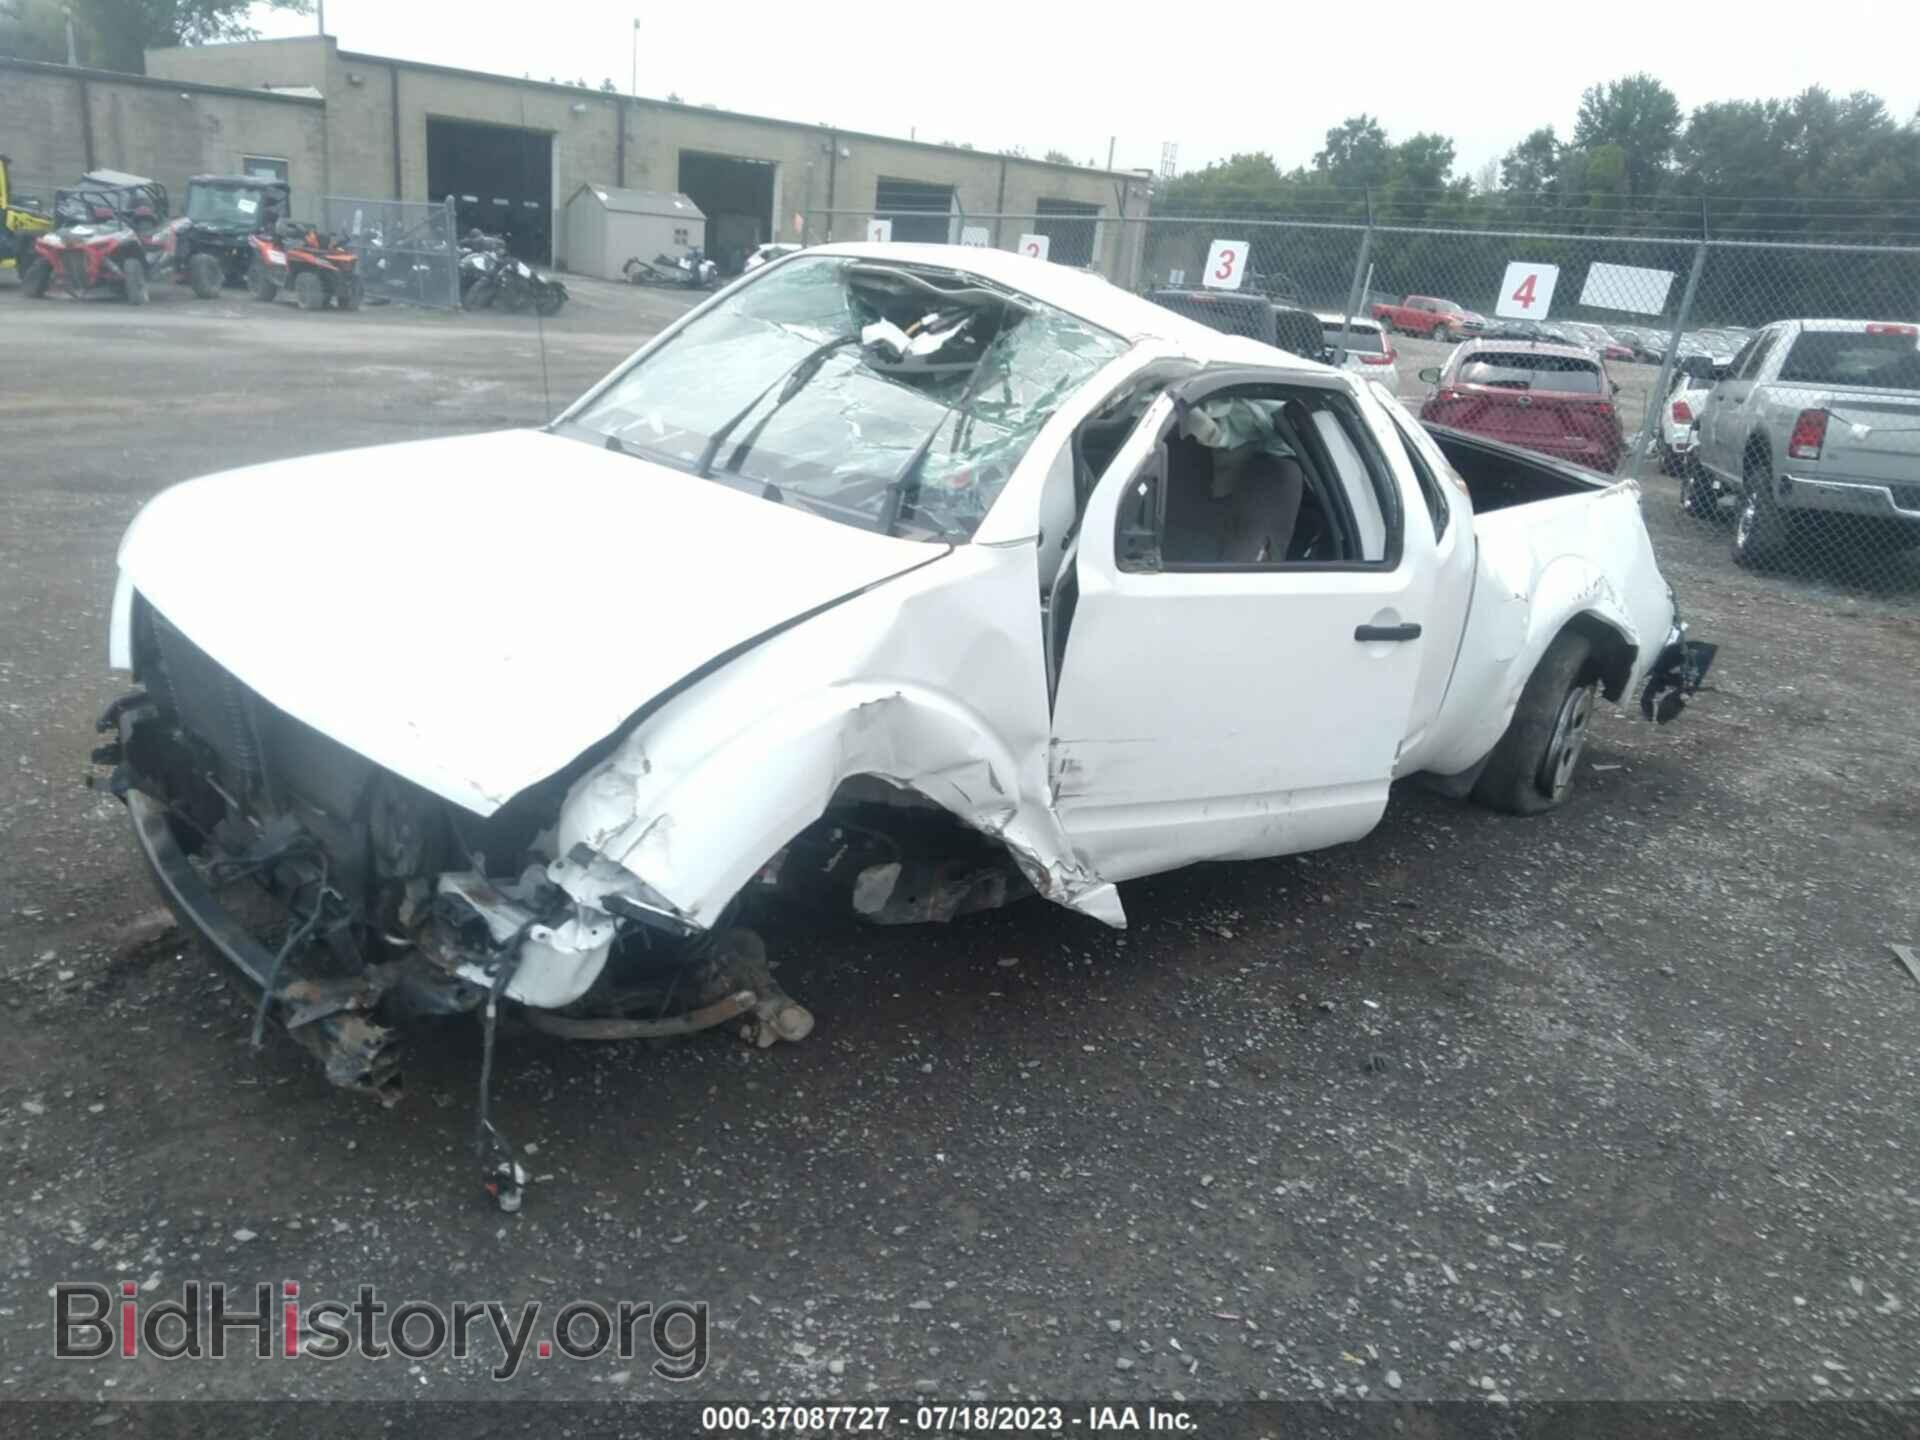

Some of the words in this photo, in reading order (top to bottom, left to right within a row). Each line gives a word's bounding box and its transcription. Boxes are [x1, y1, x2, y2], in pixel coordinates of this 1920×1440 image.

[873, 227, 884, 242] 1
[1215, 250, 1235, 280] 3
[1512, 274, 1537, 309] 4
